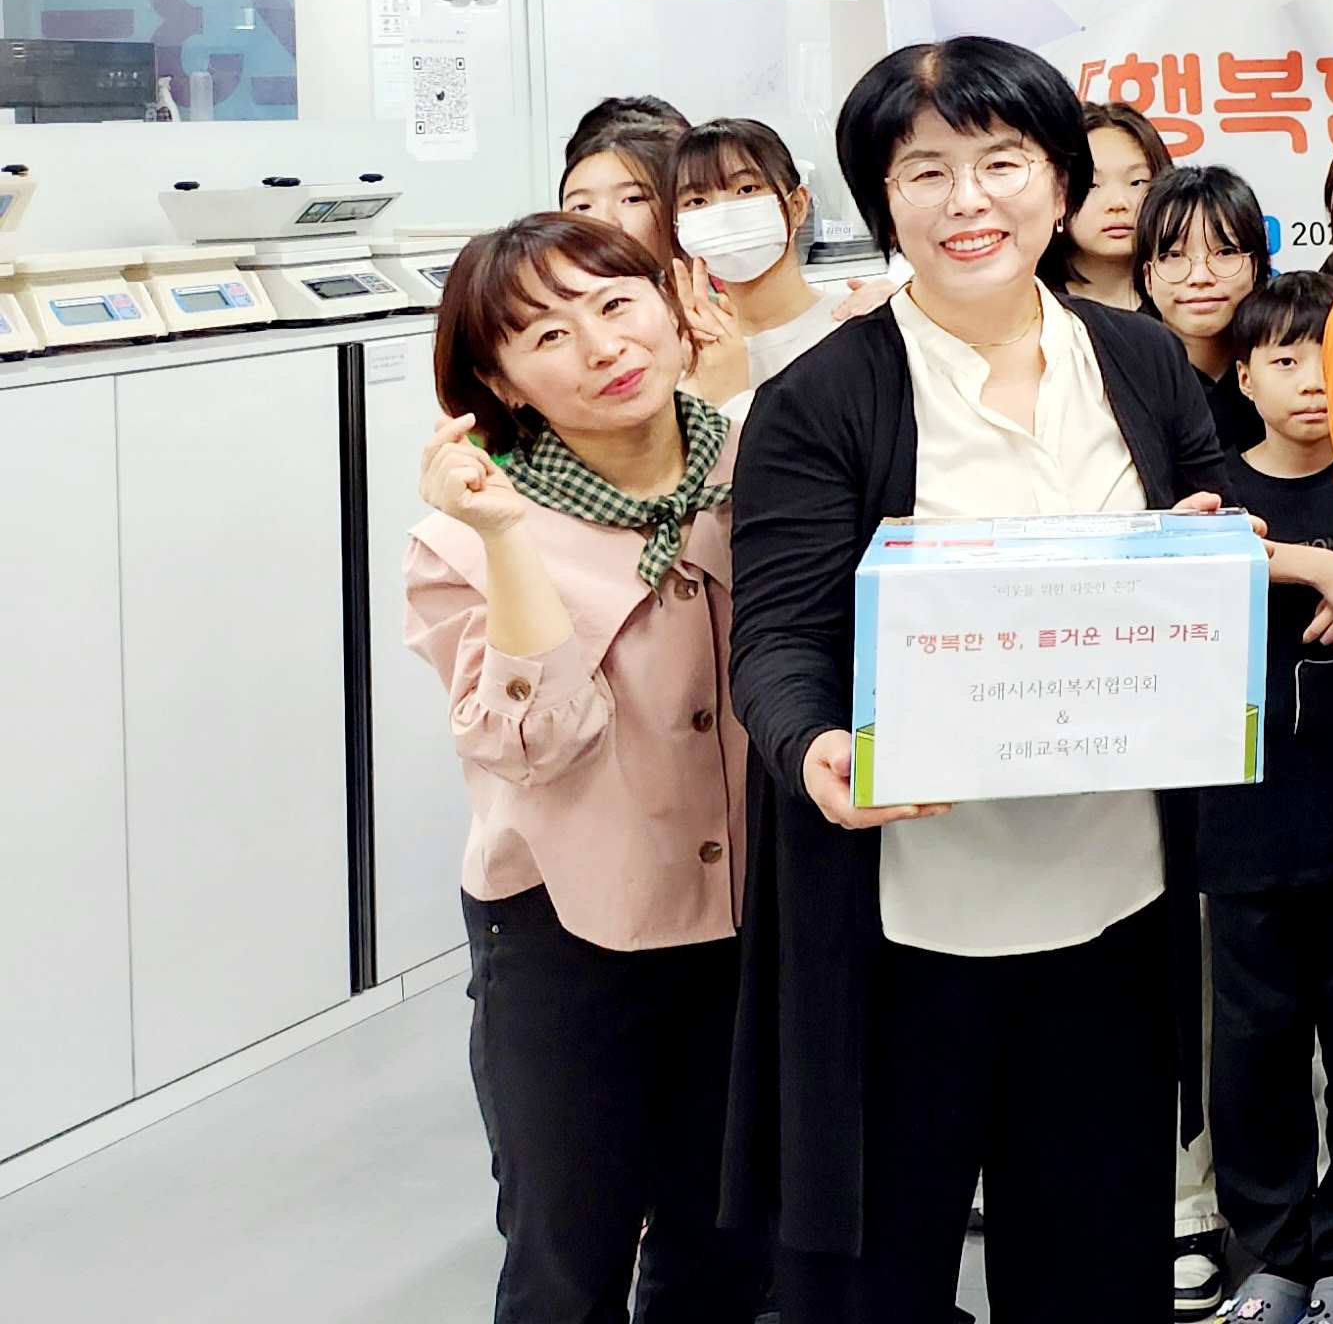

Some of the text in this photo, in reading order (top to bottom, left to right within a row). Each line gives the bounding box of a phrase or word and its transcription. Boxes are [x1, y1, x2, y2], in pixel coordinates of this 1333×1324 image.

[906, 631, 984, 655] 『행복한
[1038, 626, 1101, 649] 즐거운
[1115, 625, 1155, 644] 나의
[1168, 623, 1220, 643] 가족』
[1056, 709, 1070, 726] &
